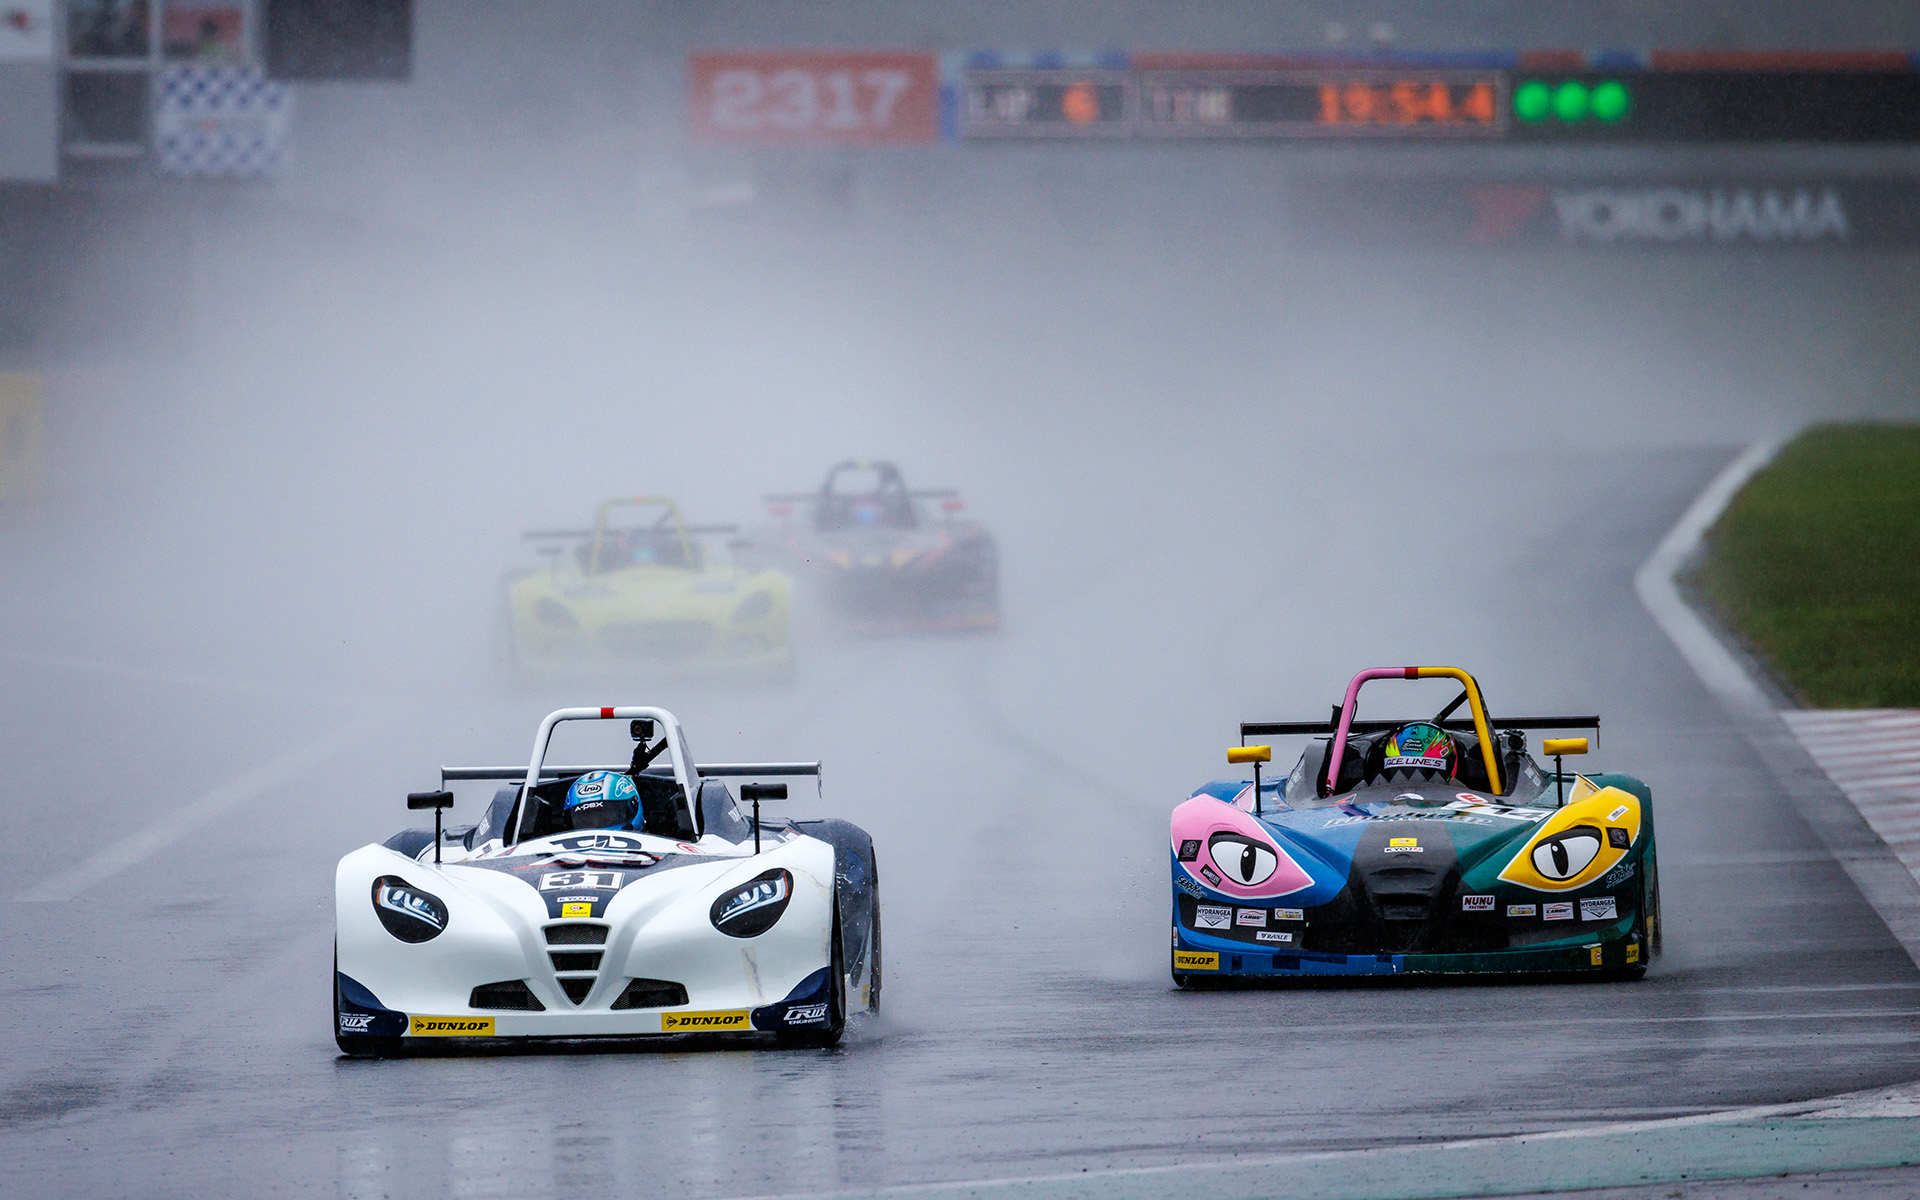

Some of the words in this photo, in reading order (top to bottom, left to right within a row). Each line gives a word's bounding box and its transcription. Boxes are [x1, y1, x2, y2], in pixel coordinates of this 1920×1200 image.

[711, 68, 910, 129] 2317
[1061, 80, 1099, 125] 6
[1318, 81, 1496, 126] 19:54.4
[1553, 188, 1849, 240] YOKOHAMA
[1405, 757, 1443, 768] LINE'S
[548, 872, 615, 887] 31
[1464, 896, 1494, 906] NUNU
[1197, 908, 1231, 916] HYDRANGEA
[425, 1021, 489, 1031] DUNLOP
[679, 1015, 744, 1026] DUNLOP
